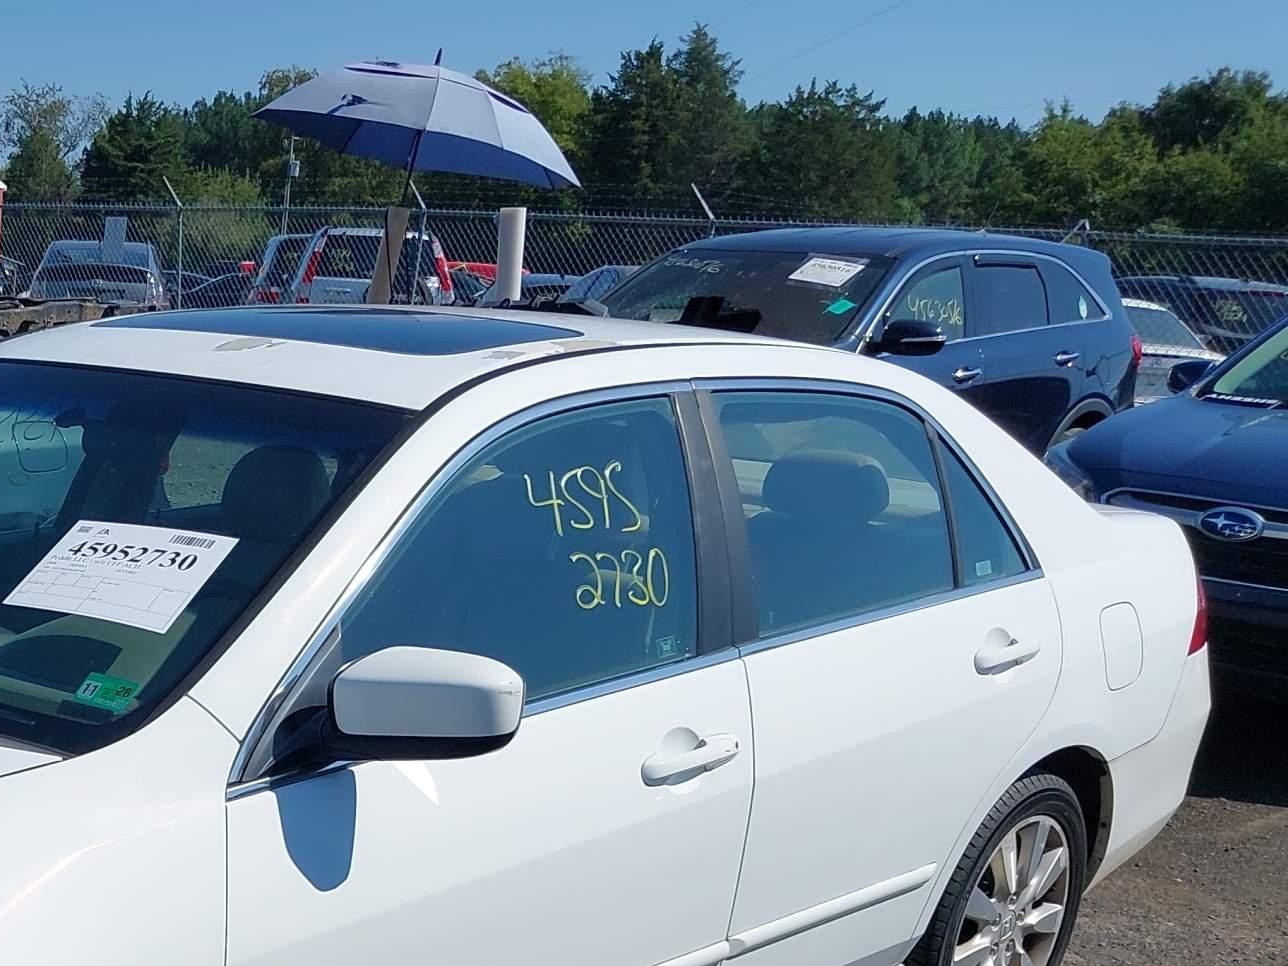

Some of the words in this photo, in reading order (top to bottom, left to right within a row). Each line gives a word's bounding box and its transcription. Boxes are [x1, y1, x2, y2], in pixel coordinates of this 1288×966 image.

[522, 458, 642, 538] 4595
[68, 540, 198, 571] 45952730
[568, 547, 669, 611] 2730
